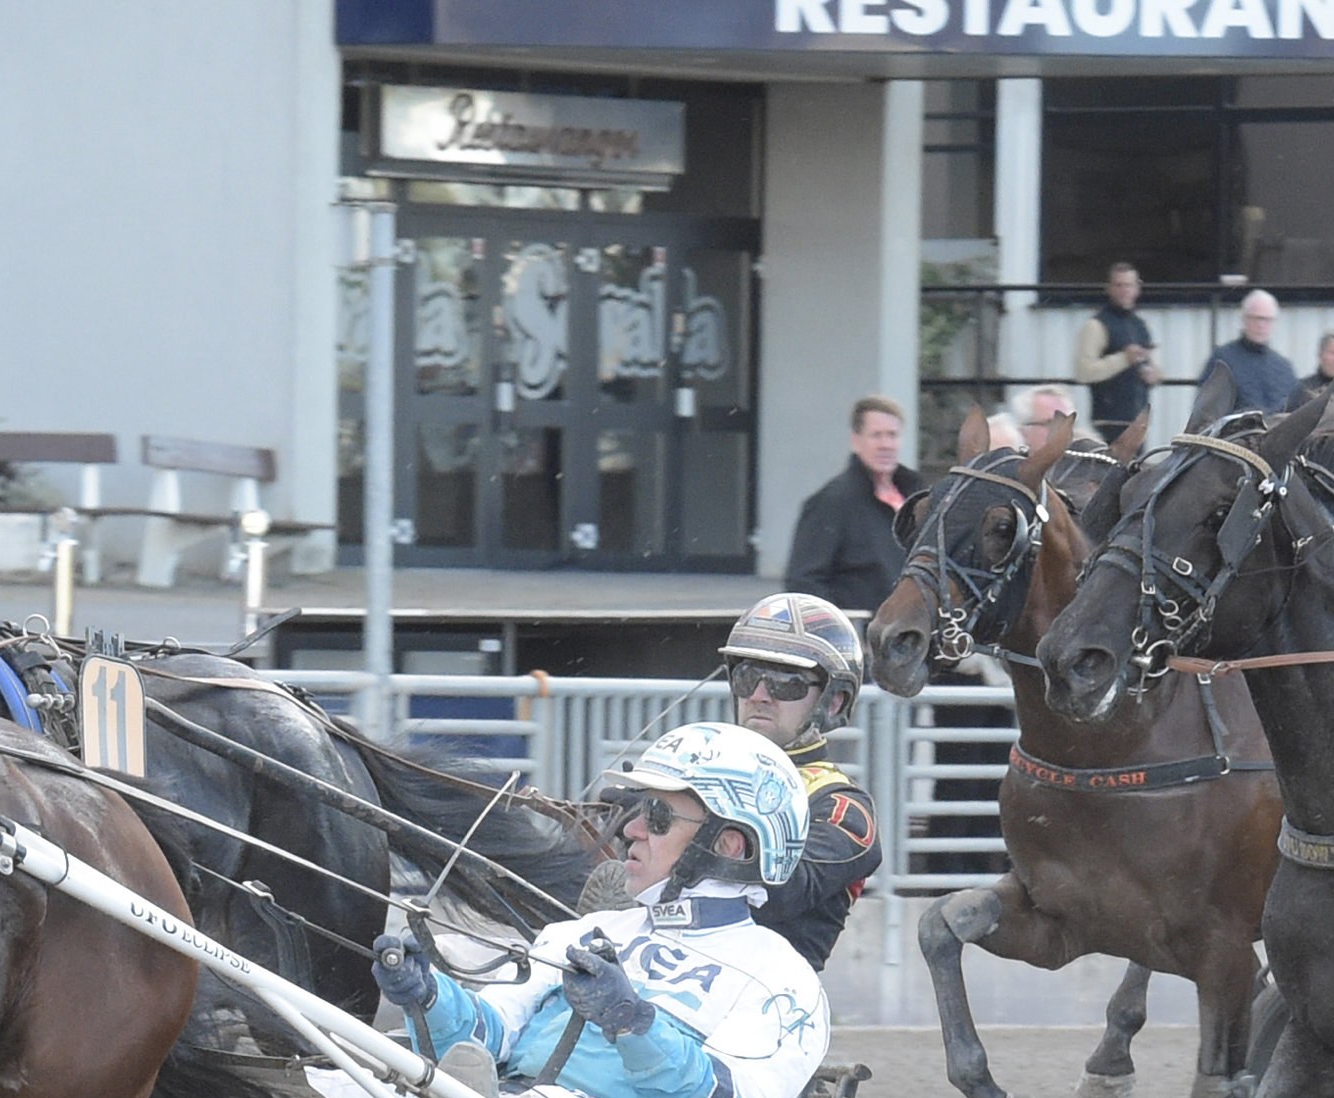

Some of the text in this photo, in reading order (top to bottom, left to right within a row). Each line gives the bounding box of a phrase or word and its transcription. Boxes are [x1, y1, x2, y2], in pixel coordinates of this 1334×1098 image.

[92, 665, 127, 774] 11
[655, 733, 685, 754] EA
[1089, 771, 1147, 788] CASH
[828, 792, 878, 849] D
[652, 904, 687, 918] SVEA
[181, 929, 251, 975] ECLIPSE
